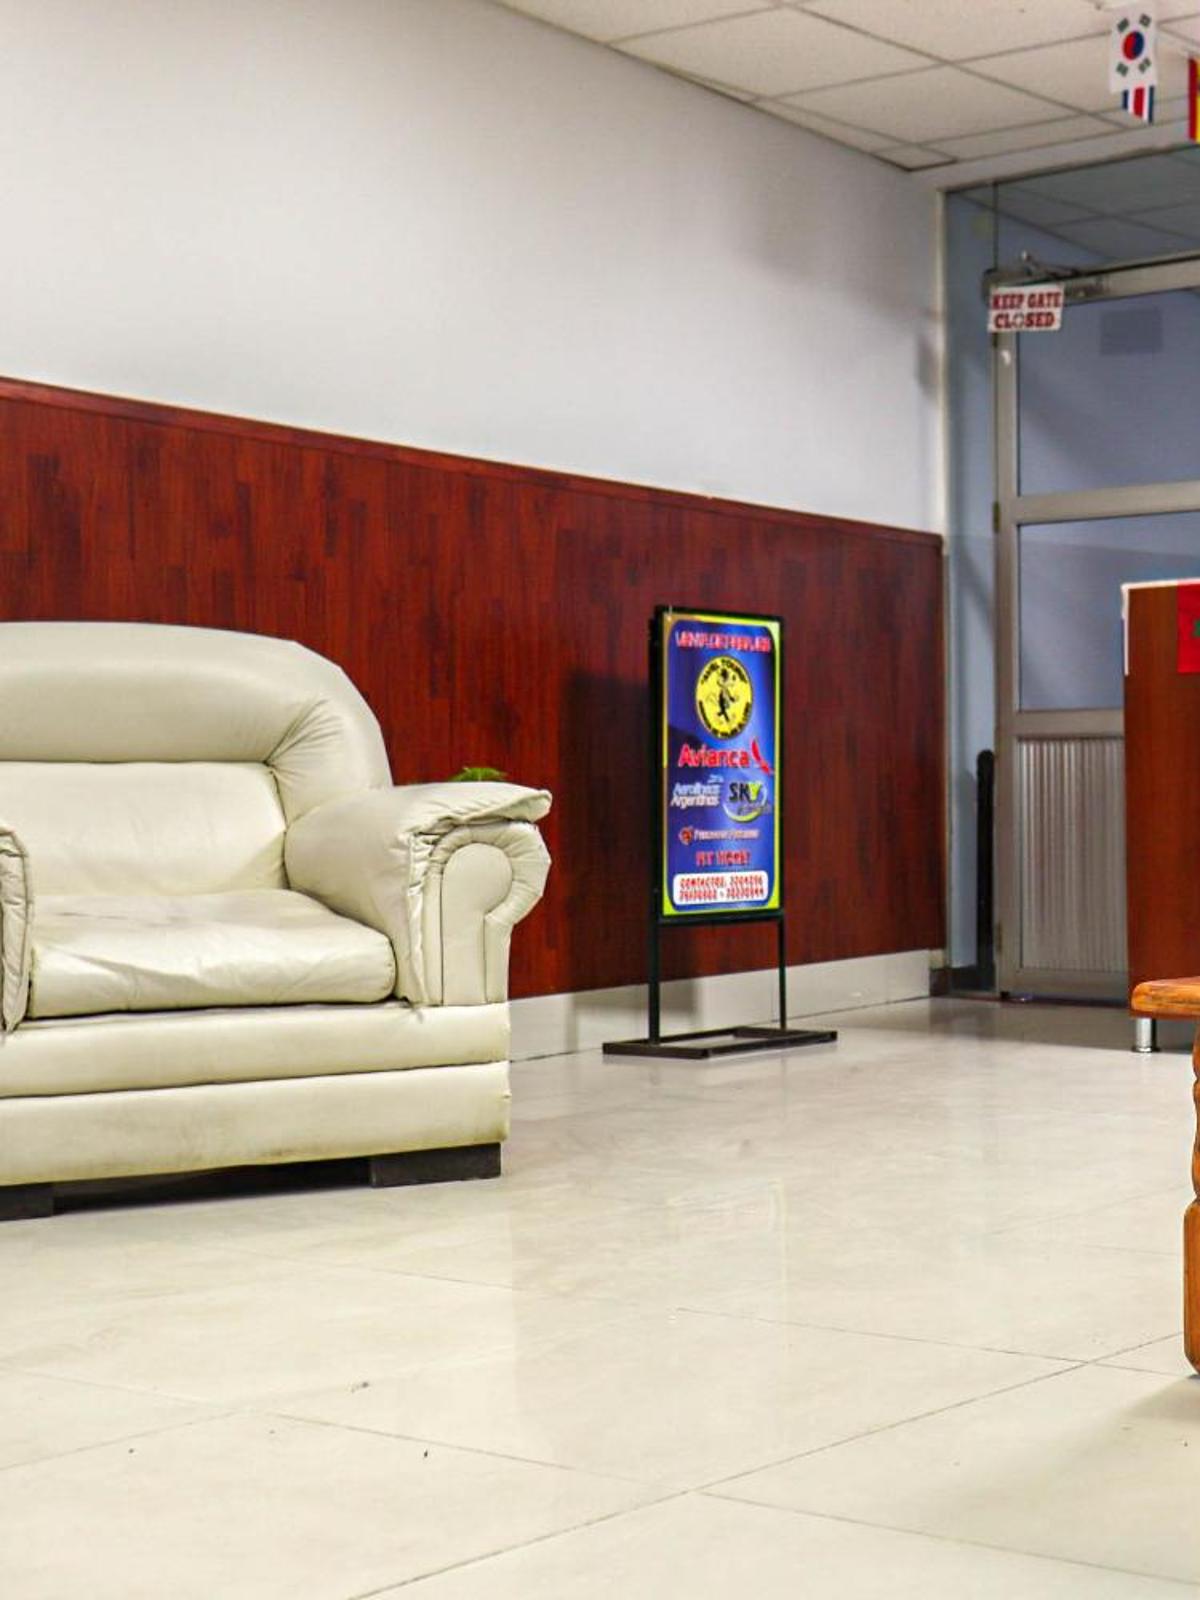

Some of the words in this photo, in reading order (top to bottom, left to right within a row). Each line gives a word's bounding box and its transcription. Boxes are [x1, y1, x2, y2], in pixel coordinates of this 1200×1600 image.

[993, 293, 1024, 310] KEEP
[1028, 292, 1061, 308] GATE
[995, 311, 1055, 329] CLOSED
[678, 743, 750, 768] Avianca
[729, 781, 763, 803] SKY
